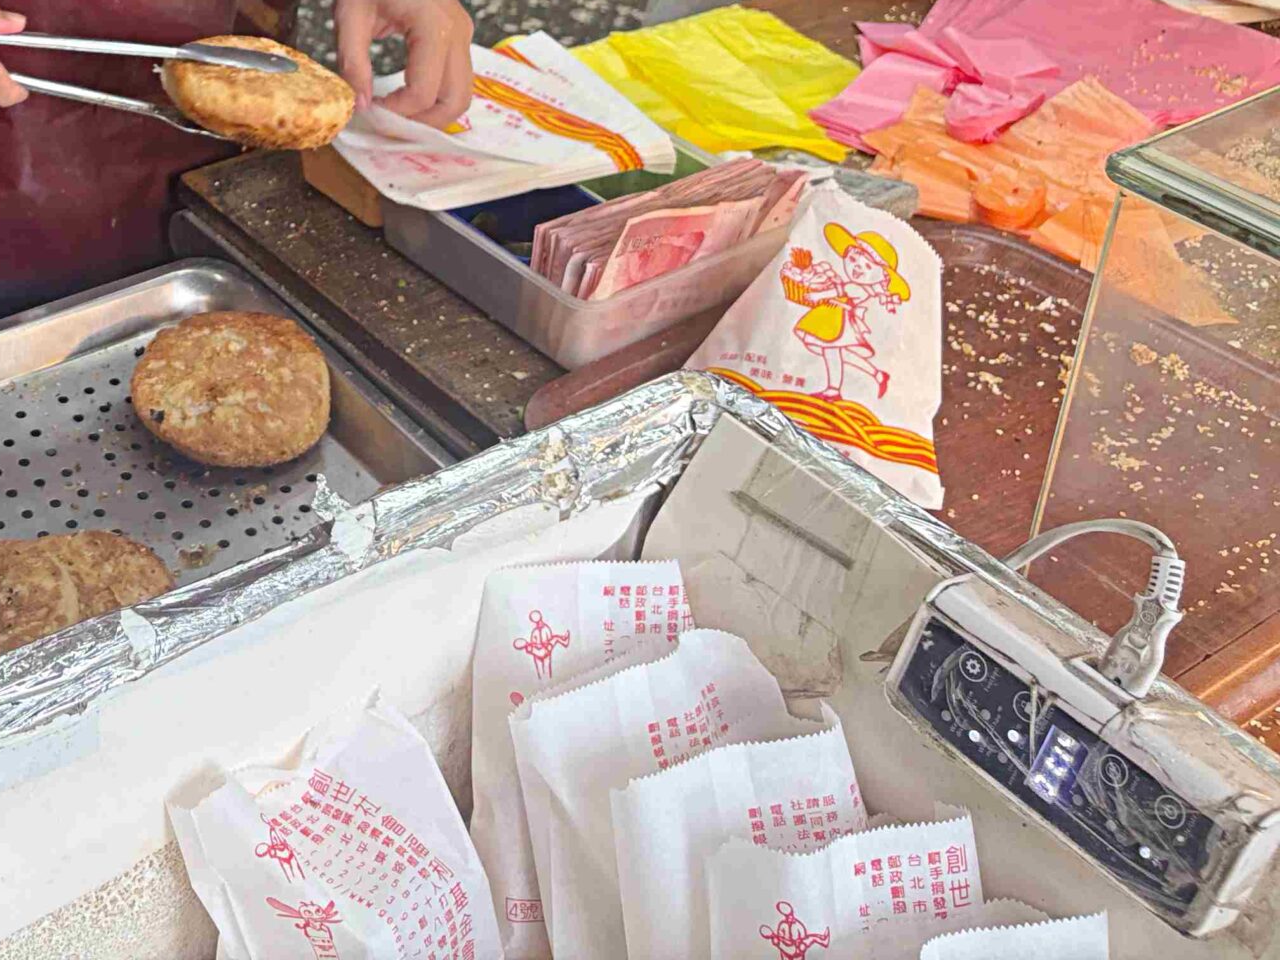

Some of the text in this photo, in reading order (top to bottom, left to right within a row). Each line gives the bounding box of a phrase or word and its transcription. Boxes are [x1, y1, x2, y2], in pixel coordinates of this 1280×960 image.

[908, 854, 927, 913] 台北市
[945, 844, 972, 908] 創世
[509, 902, 538, 920] 4號
